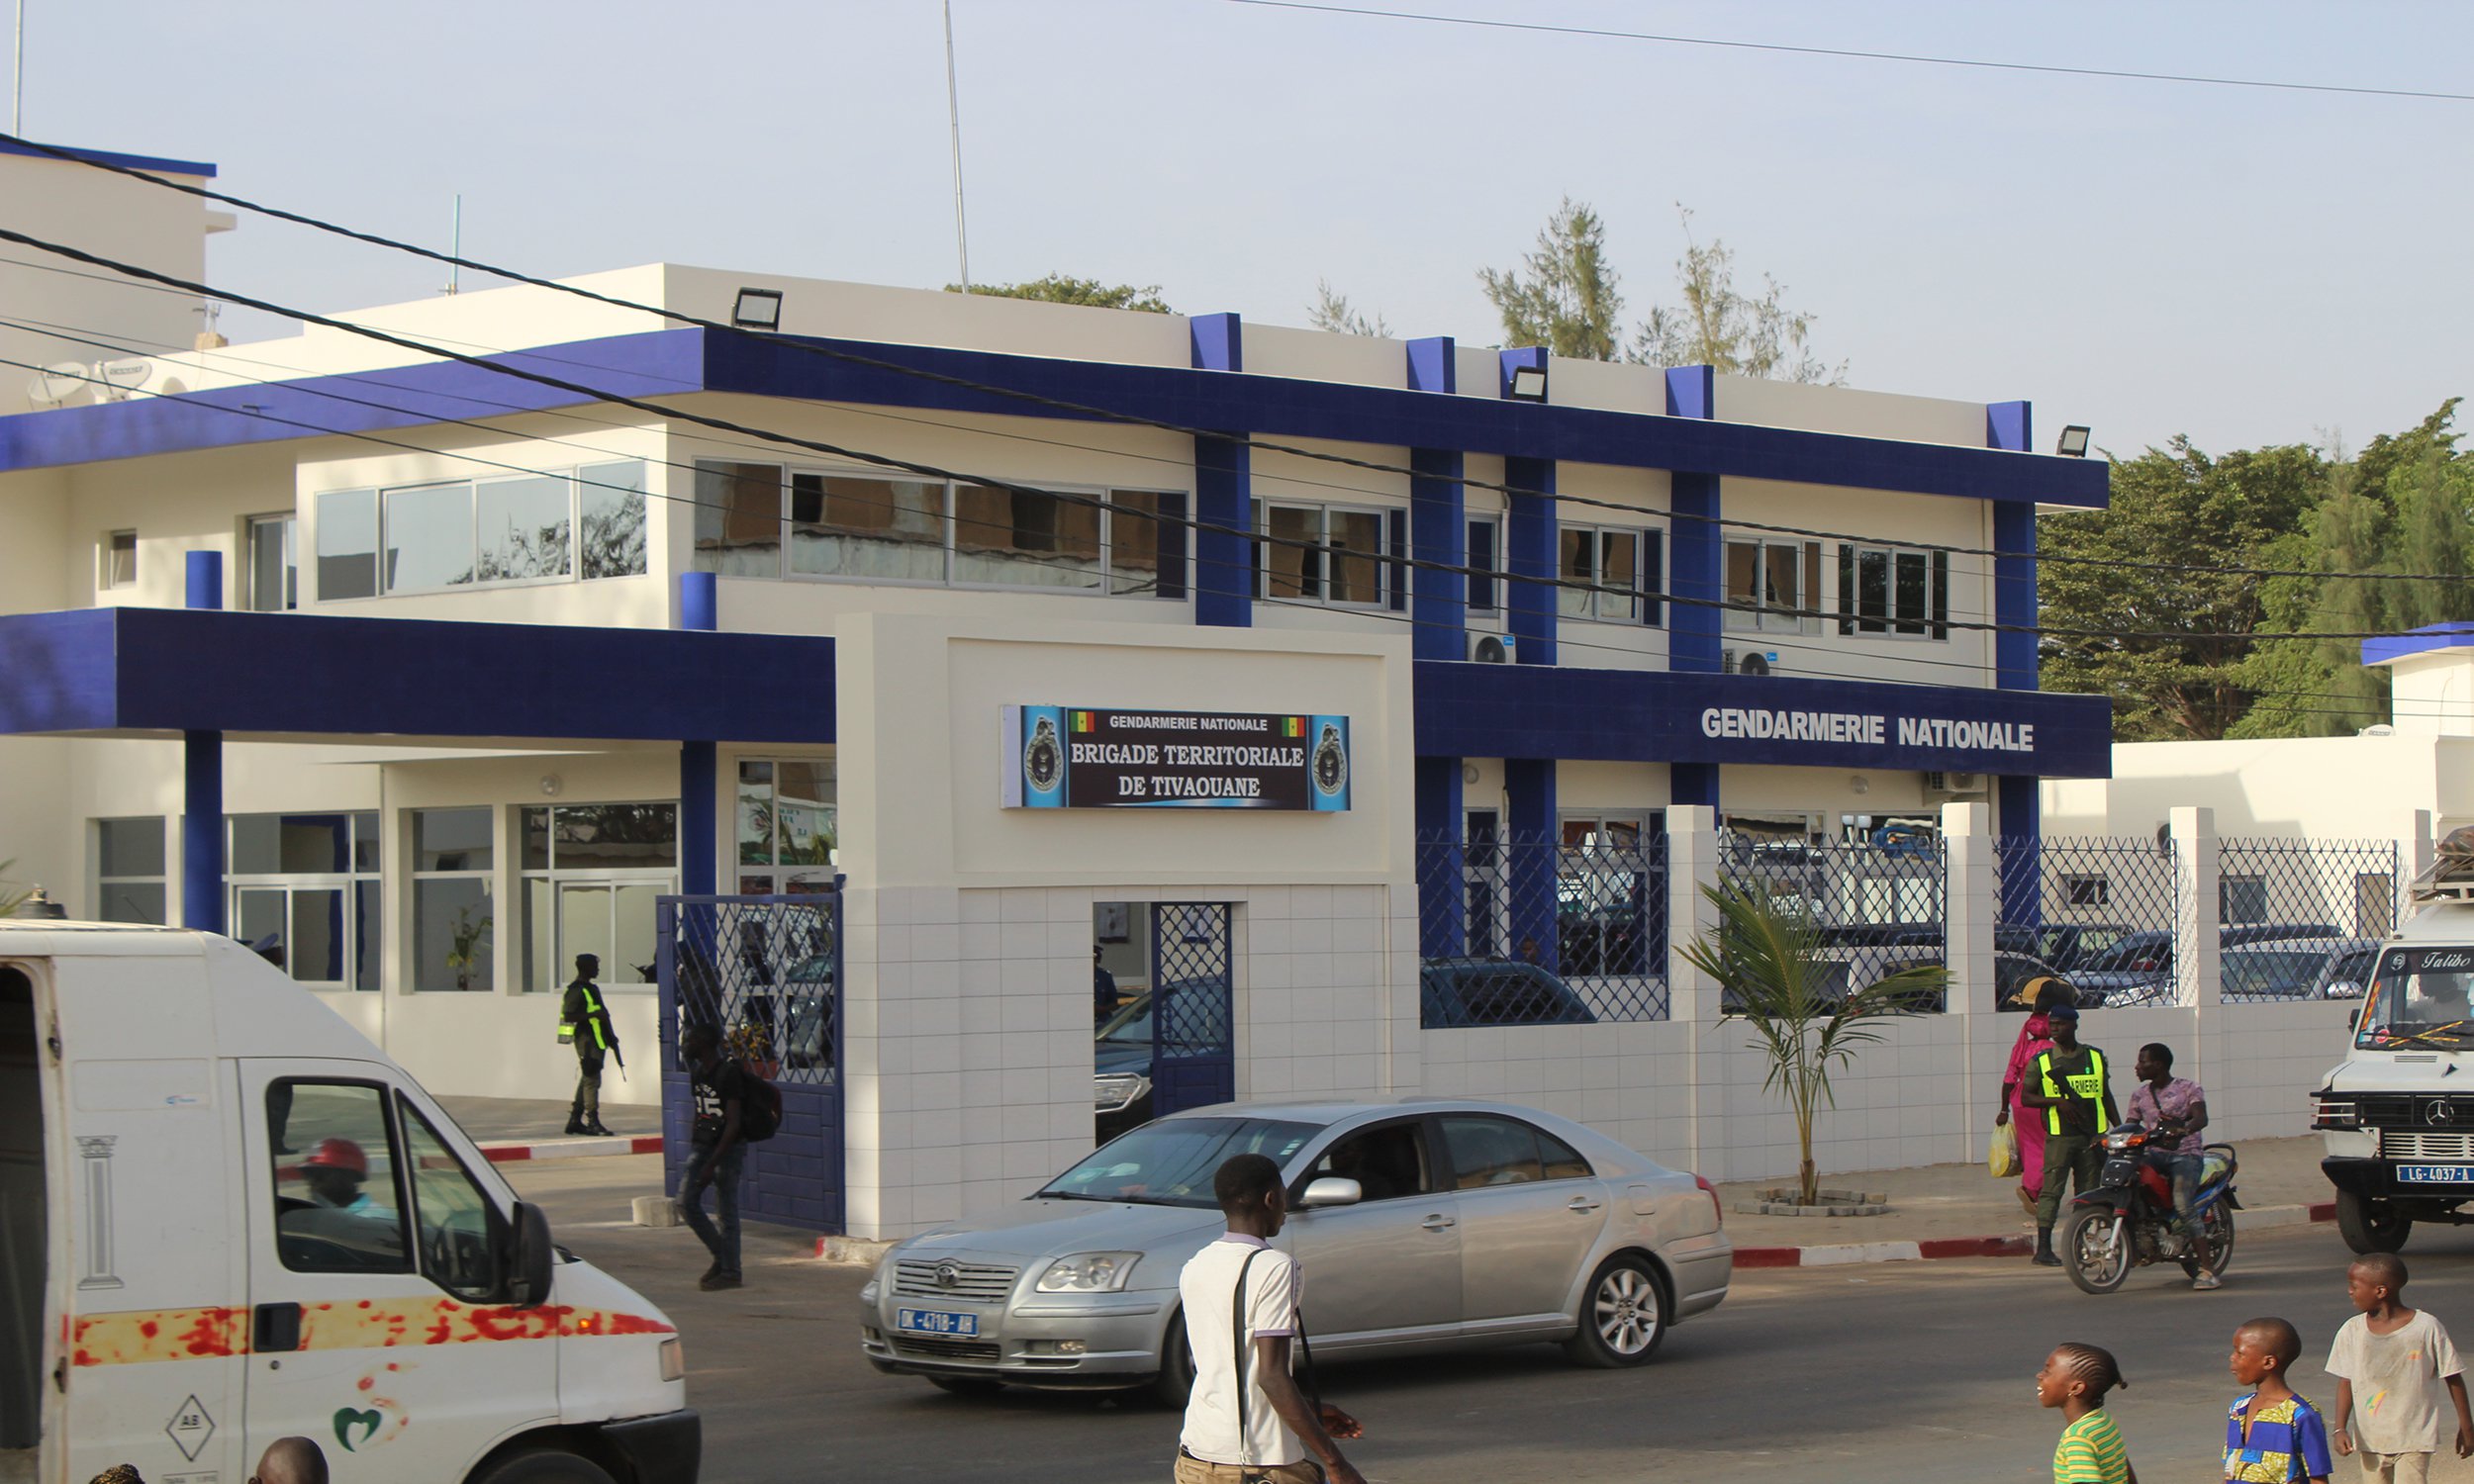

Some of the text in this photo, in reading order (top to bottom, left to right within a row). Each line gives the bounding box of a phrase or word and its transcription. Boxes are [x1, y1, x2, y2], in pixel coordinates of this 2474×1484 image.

[1109, 715, 1268, 731] GENDARMERIE NATIONALE
[1701, 707, 2035, 752] GENDARMERIE NATIONALE
[1071, 743, 1304, 767] BRIGADE TERRITORIALE
[1119, 776, 1261, 797] DE TIVAOUANE
